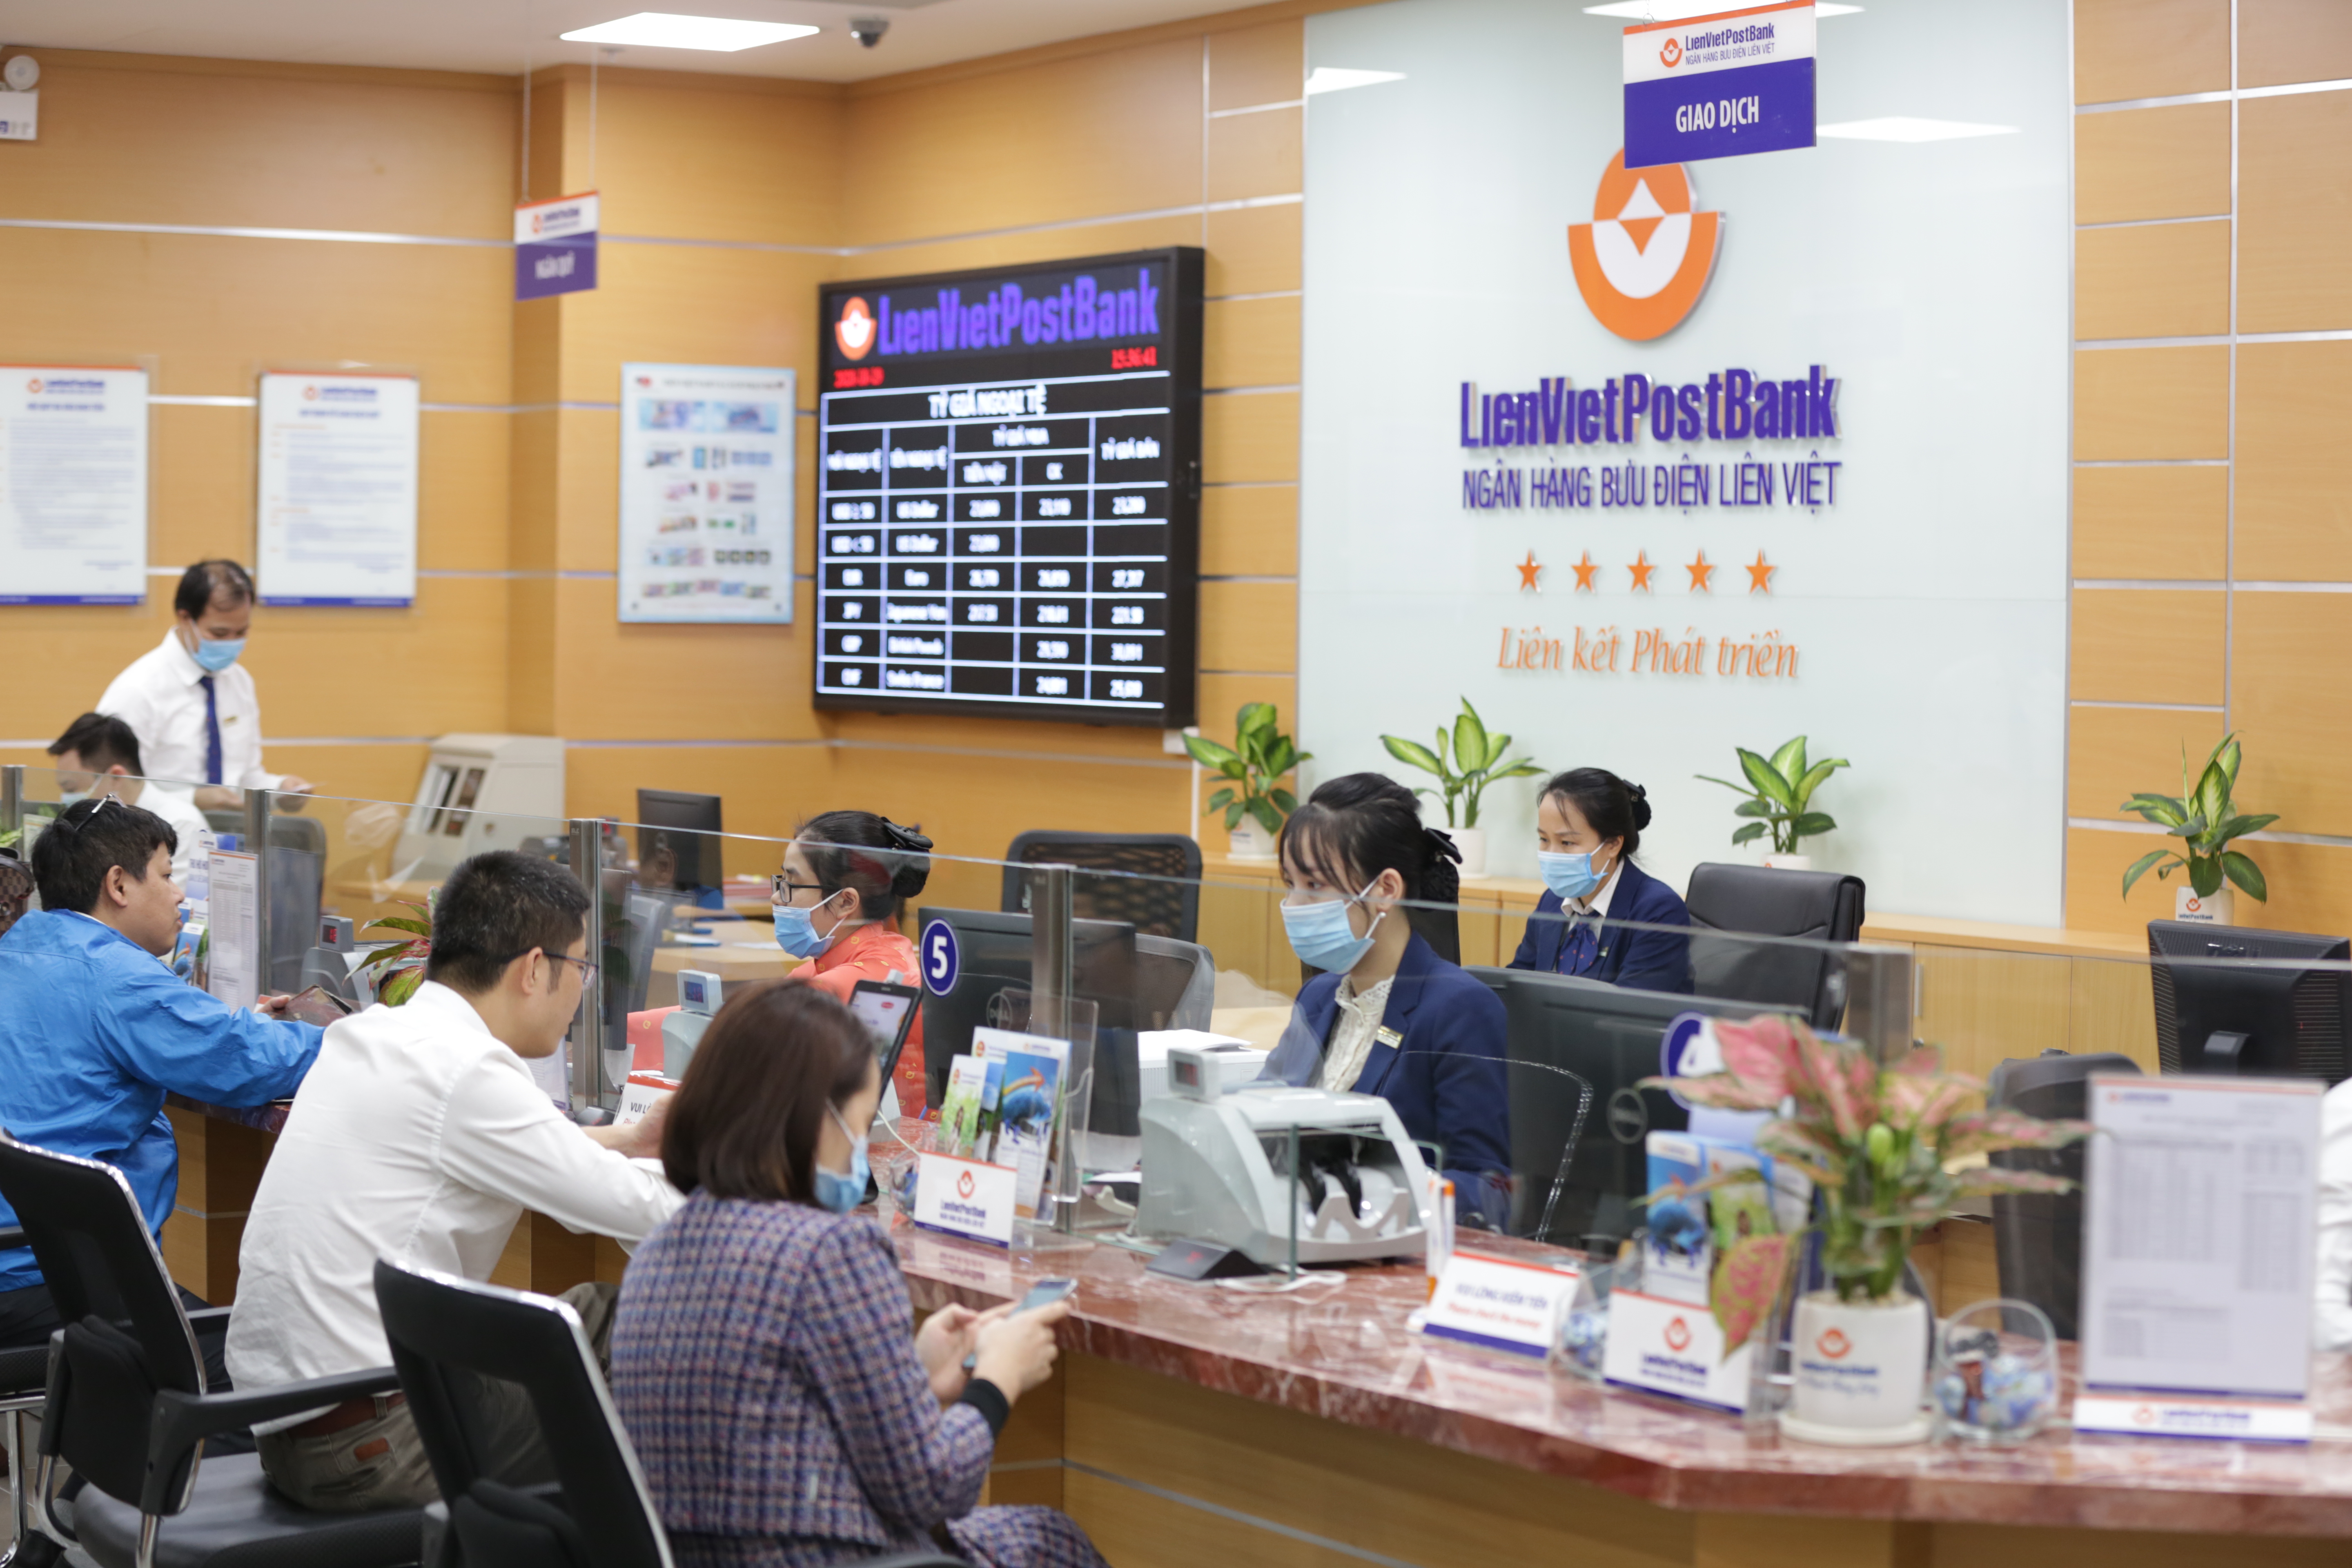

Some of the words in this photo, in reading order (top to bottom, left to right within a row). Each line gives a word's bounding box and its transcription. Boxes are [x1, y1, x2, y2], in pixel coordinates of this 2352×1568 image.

[1686, 23, 1775, 51] LienVietPostBank
[1686, 53, 1701, 65] NGÂN
[1702, 50, 1718, 63] HÀNG
[1733, 46, 1746, 60] ĐIỆN
[1748, 44, 1761, 58] LIÊN
[1762, 42, 1775, 55] VIỆT
[1675, 101, 1716, 133] GIAO
[1719, 96, 1760, 134] DỊCH
[878, 268, 1160, 356] LienVietPostBank
[1461, 365, 1838, 448] LienVietPostBank
[1463, 458, 1521, 509] NGÂN
[1531, 457, 1591, 508] HÀNG
[1654, 452, 1710, 515] ĐIỆN
[1719, 451, 1773, 506] LIÊN
[1783, 450, 1842, 514] VIỆT
[1497, 626, 1562, 669] Liên
[1572, 625, 1620, 673] kết
[1628, 626, 1705, 675] Phát
[1717, 629, 1799, 678] triển
[931, 935, 948, 979] 5
[630, 1102, 642, 1113] VUI
